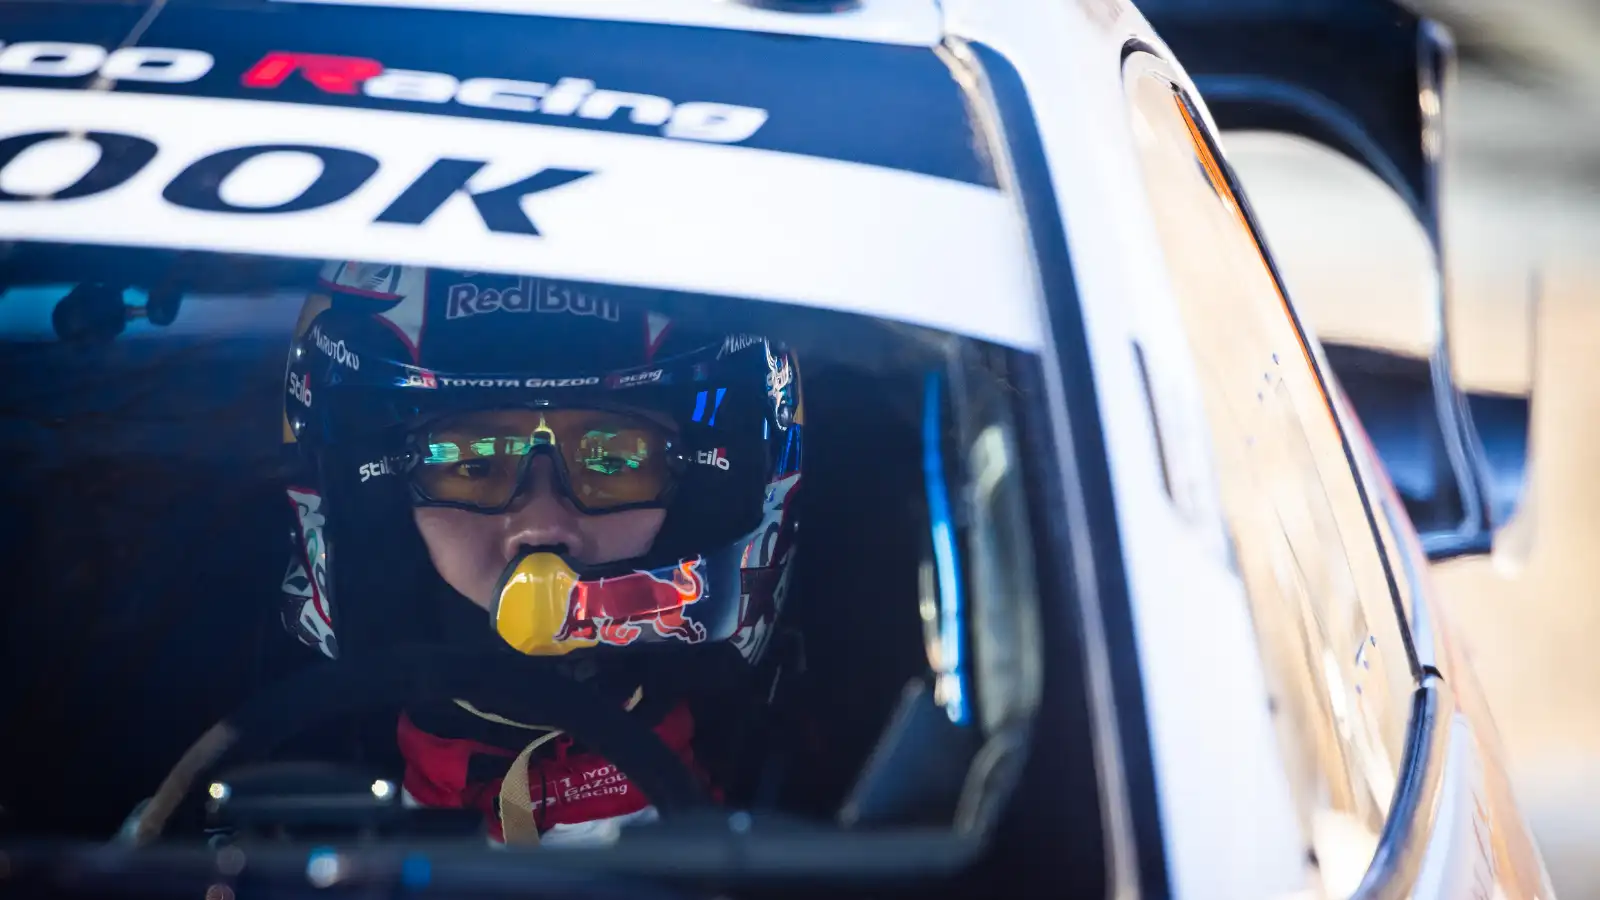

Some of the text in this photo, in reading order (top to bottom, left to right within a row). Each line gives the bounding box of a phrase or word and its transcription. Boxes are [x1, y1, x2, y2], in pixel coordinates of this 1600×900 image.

[0, 38, 767, 143] oo Racing
[446, 276, 533, 319] Red
[289, 371, 312, 407] Stilo
[439, 377, 520, 387] TOYOTA
[525, 376, 600, 388] GAZOO
[359, 455, 396, 482] Stil
[695, 447, 730, 471] tilo
[566, 784, 628, 803] Racing
